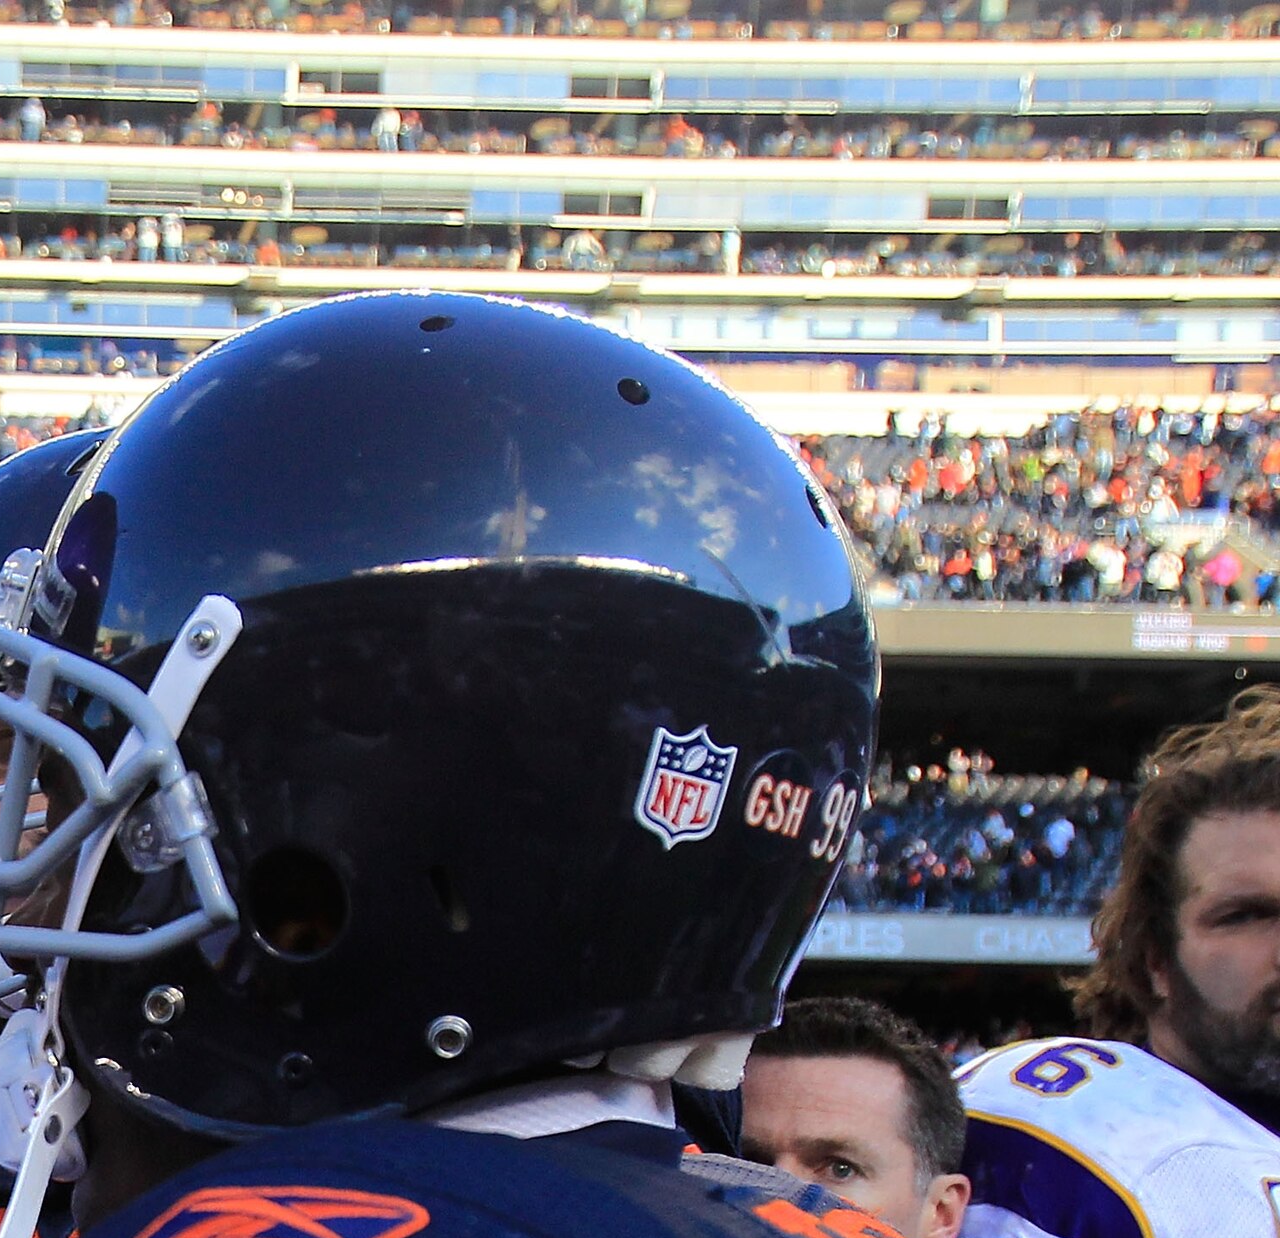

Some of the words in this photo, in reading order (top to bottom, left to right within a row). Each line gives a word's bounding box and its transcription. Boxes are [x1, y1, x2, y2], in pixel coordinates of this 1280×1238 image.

[650, 775, 710, 826] NFL
[744, 773, 813, 838] GSH
[810, 782, 857, 863] 99
[1010, 1042, 1122, 1097] 6
